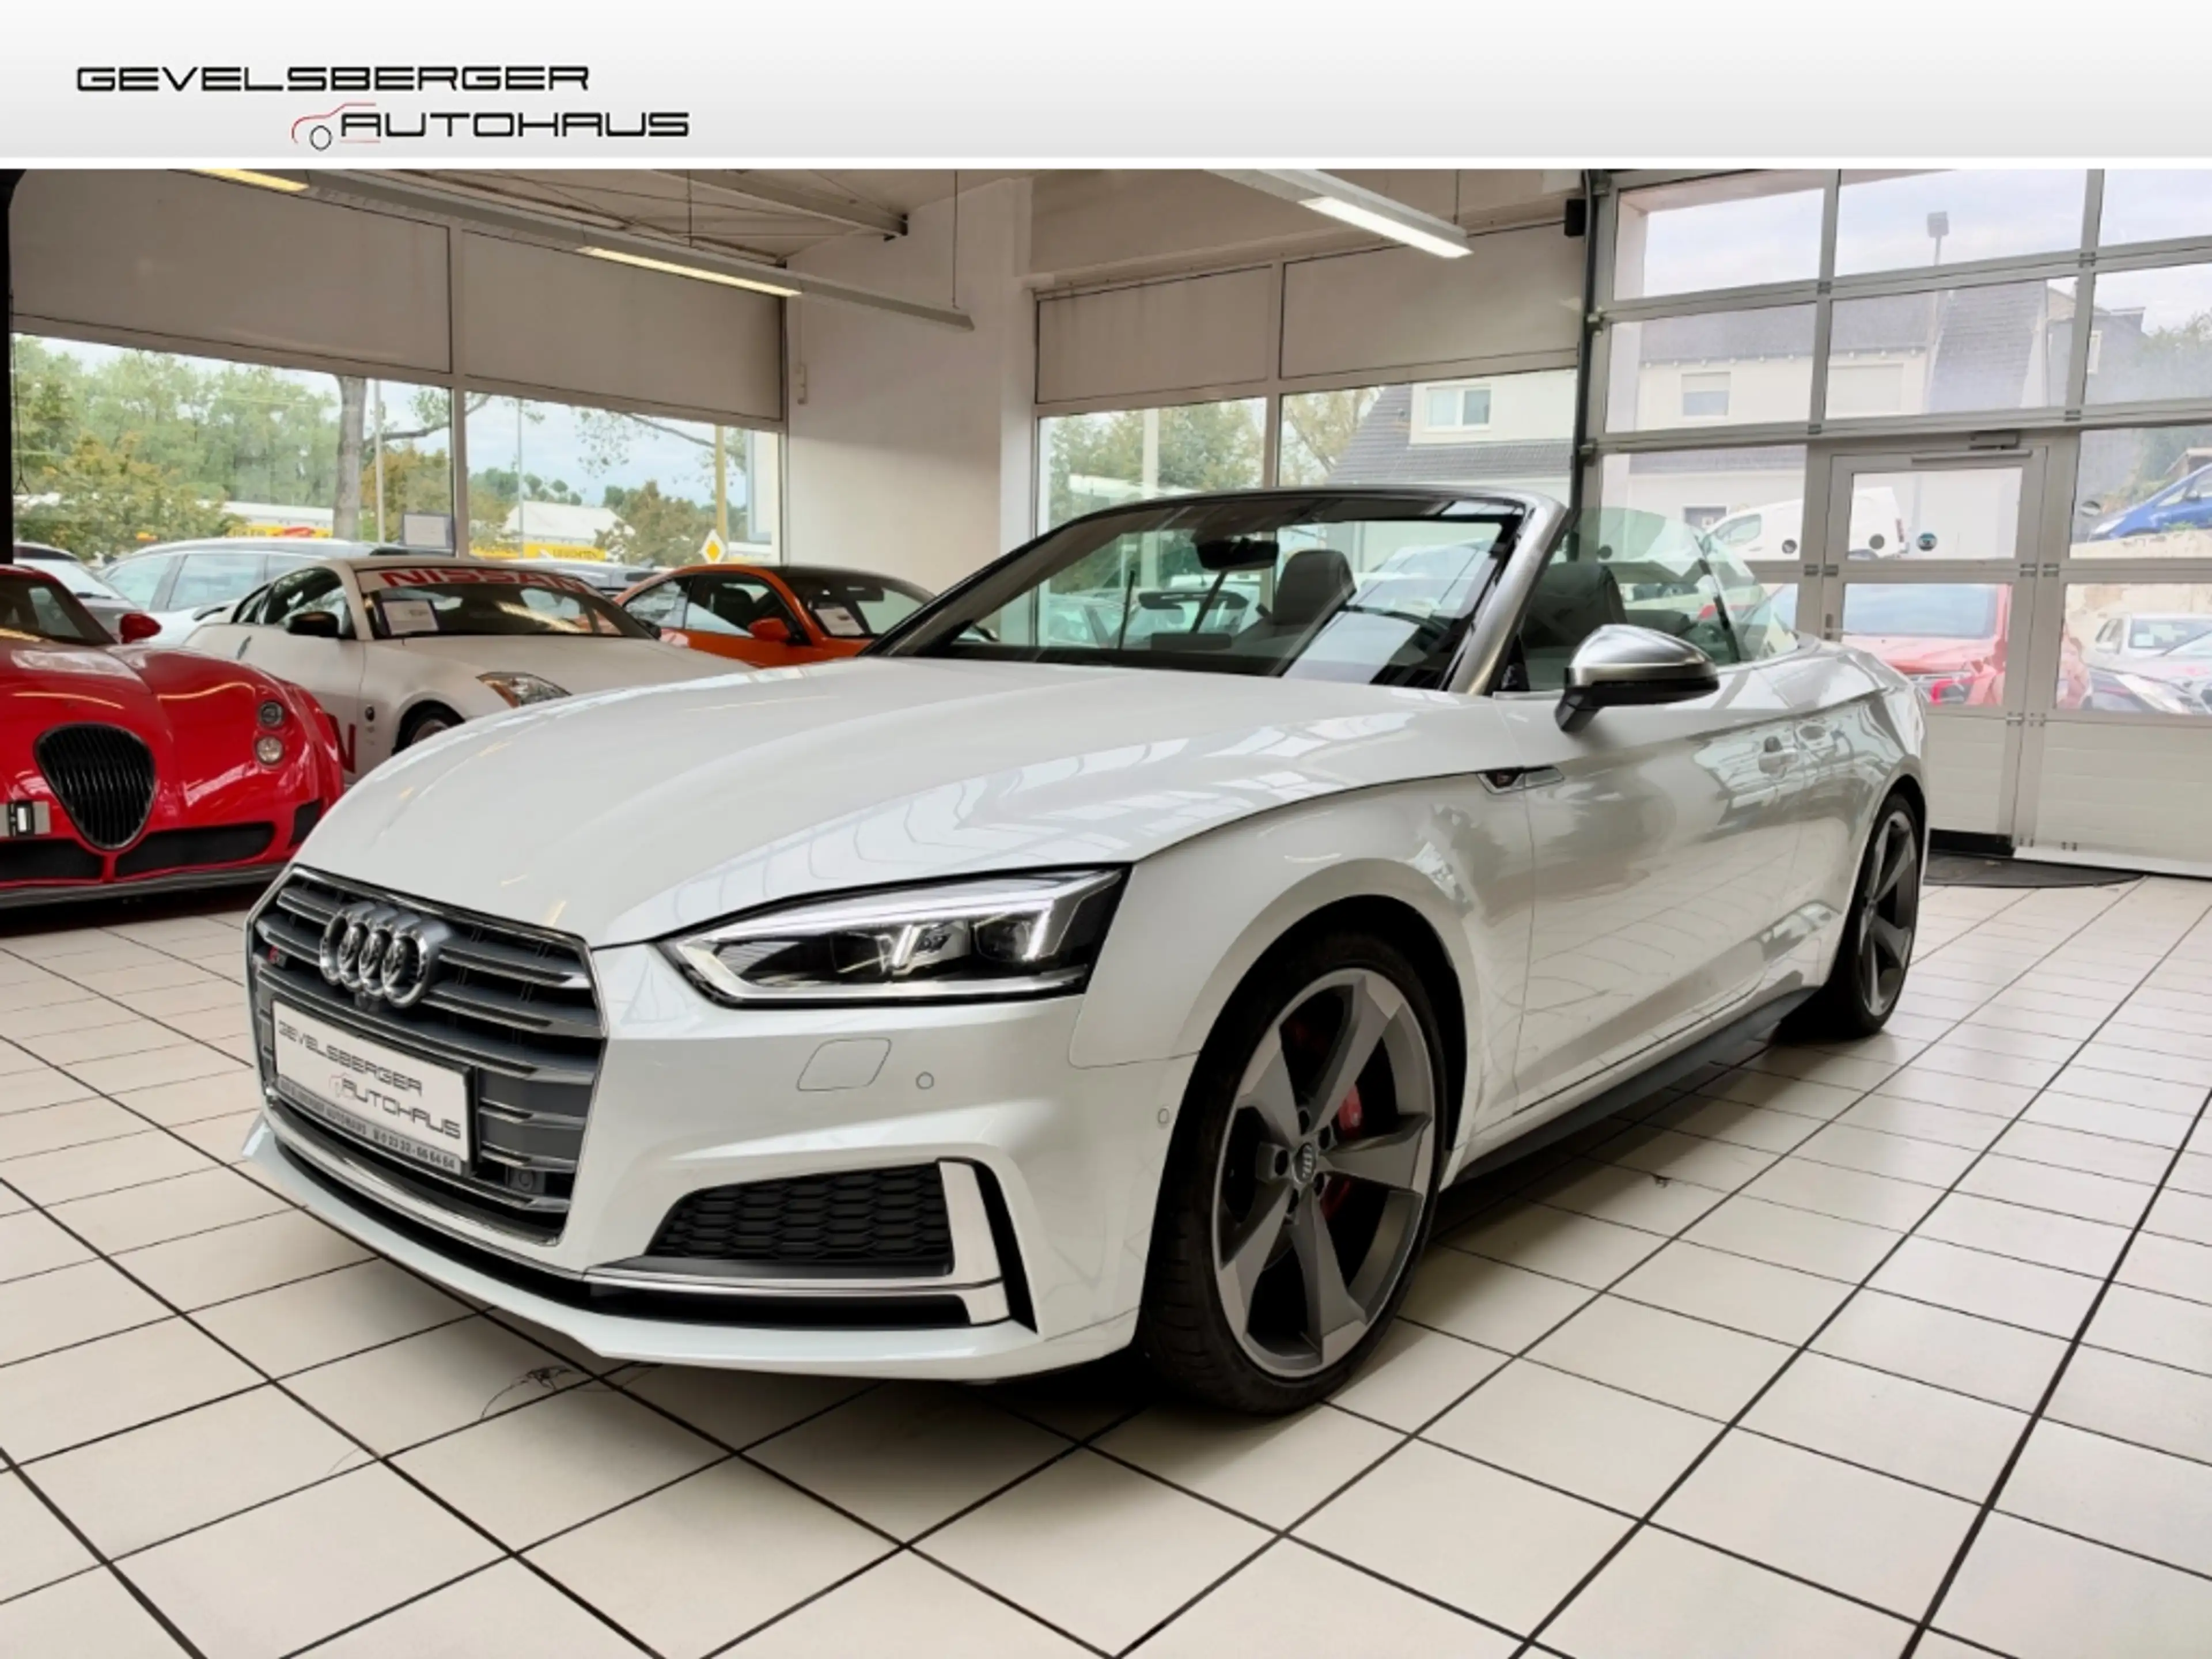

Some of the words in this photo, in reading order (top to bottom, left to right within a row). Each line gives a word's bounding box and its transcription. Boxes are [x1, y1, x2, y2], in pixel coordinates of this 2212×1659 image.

[380, 568, 588, 594] NISSAN
[278, 1019, 423, 1097] GEVELSBERGER
[342, 1078, 461, 1139] AUTOHAUS
